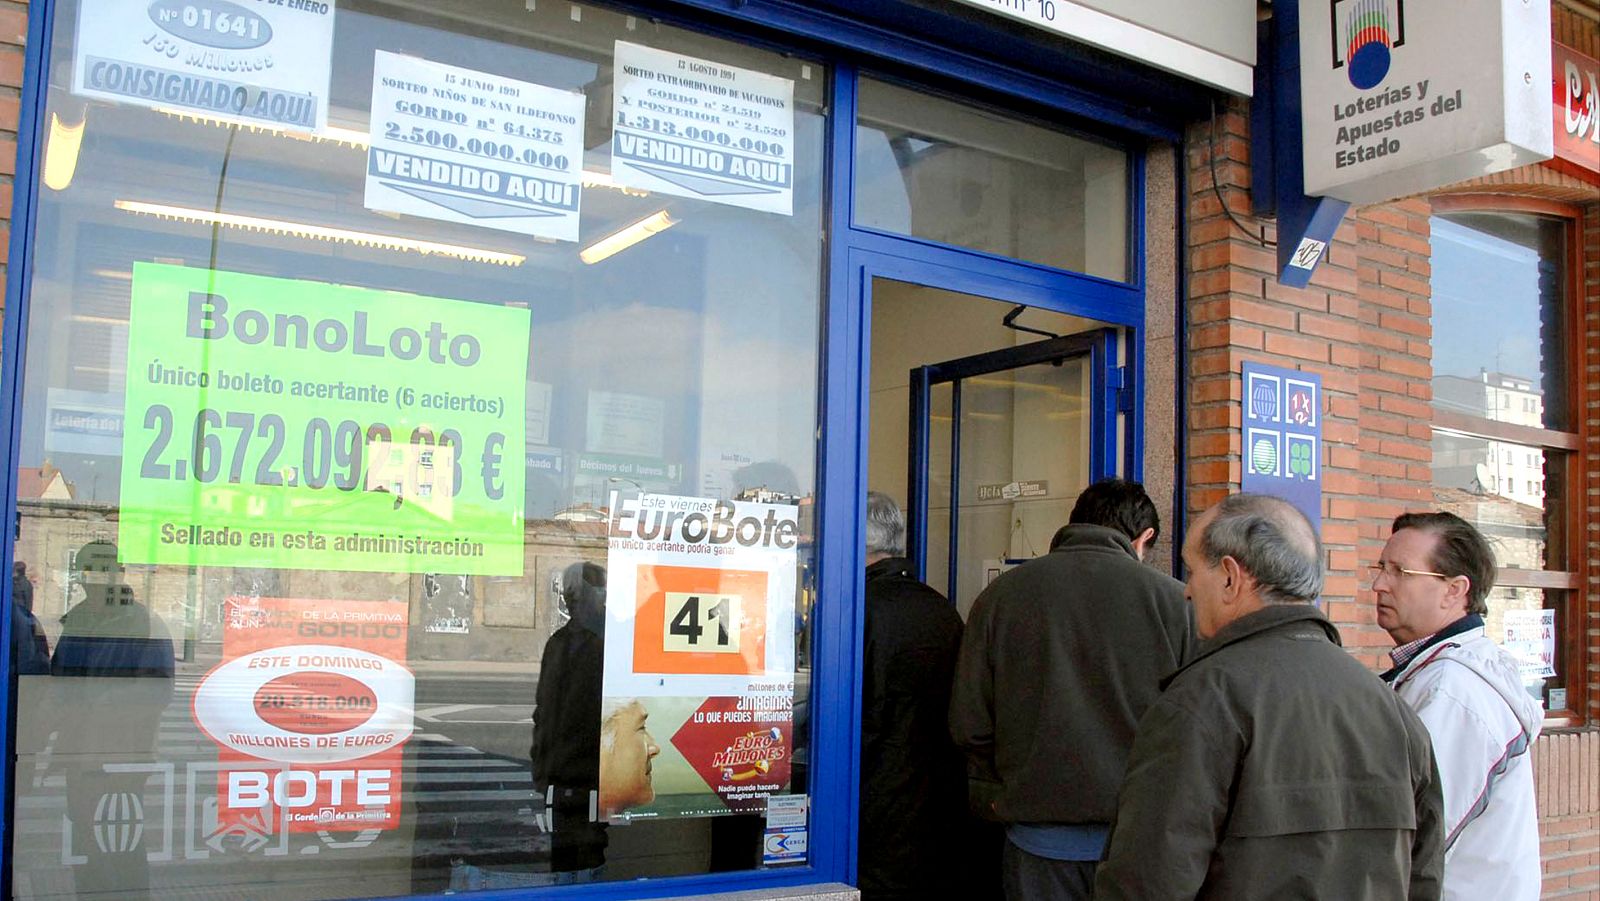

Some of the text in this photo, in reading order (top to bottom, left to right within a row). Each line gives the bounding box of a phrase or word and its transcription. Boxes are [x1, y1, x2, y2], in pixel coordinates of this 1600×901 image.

[183, 6, 260, 40] 01641
[288, 0, 329, 15] ENERO
[445, 73, 457, 85] 15
[460, 77, 494, 93] JUNIO
[678, 59, 686, 69] 13
[689, 62, 718, 77] AGOSTO
[91, 61, 247, 112] CONSIGNADO
[382, 77, 577, 126] SORTEO NIÑOS DE SAN ILDEFONSO
[623, 65, 785, 109] SORTEO EXTRAORDINARIO DE VACACIONES
[647, 88, 698, 106] GORDO
[1334, 79, 1429, 122] Loterías y
[395, 100, 468, 124] GORDO
[503, 122, 564, 145] 64.375
[620, 95, 632, 107] Y
[638, 99, 720, 125] POSTERIOR
[1335, 90, 1462, 146] Apuestas del
[385, 121, 569, 171] 2.500.000.000
[618, 134, 724, 172] VENDIDO
[1335, 137, 1400, 169] Estado
[376, 150, 500, 193] VENDIDO
[186, 291, 481, 367] BonoLoto
[148, 359, 505, 419] Único boleto acertante (6 aciertos)
[480, 432, 506, 502] €
[641, 495, 713, 512] Este viernes
[608, 493, 799, 550] EuroBote
[161, 523, 484, 558] Sellado en esta administración
[647, 541, 684, 553] acertante
[297, 622, 402, 639] GORDO
[302, 610, 320, 620] DE
[324, 611, 339, 620] LA
[343, 611, 404, 622] PRIMITIVA
[670, 597, 730, 645] 41
[248, 655, 384, 671] ESTE DOMINGO
[747, 683, 776, 692] millones
[778, 683, 786, 692] de
[694, 711, 793, 724] LO QUE PUEDES IMAGINAR?
[229, 733, 395, 749] MILLONES DE EUROS
[712, 746, 785, 768] MILLONES
[733, 735, 773, 752] EURO
[228, 769, 391, 808] BOTE
[737, 784, 756, 793] puede
